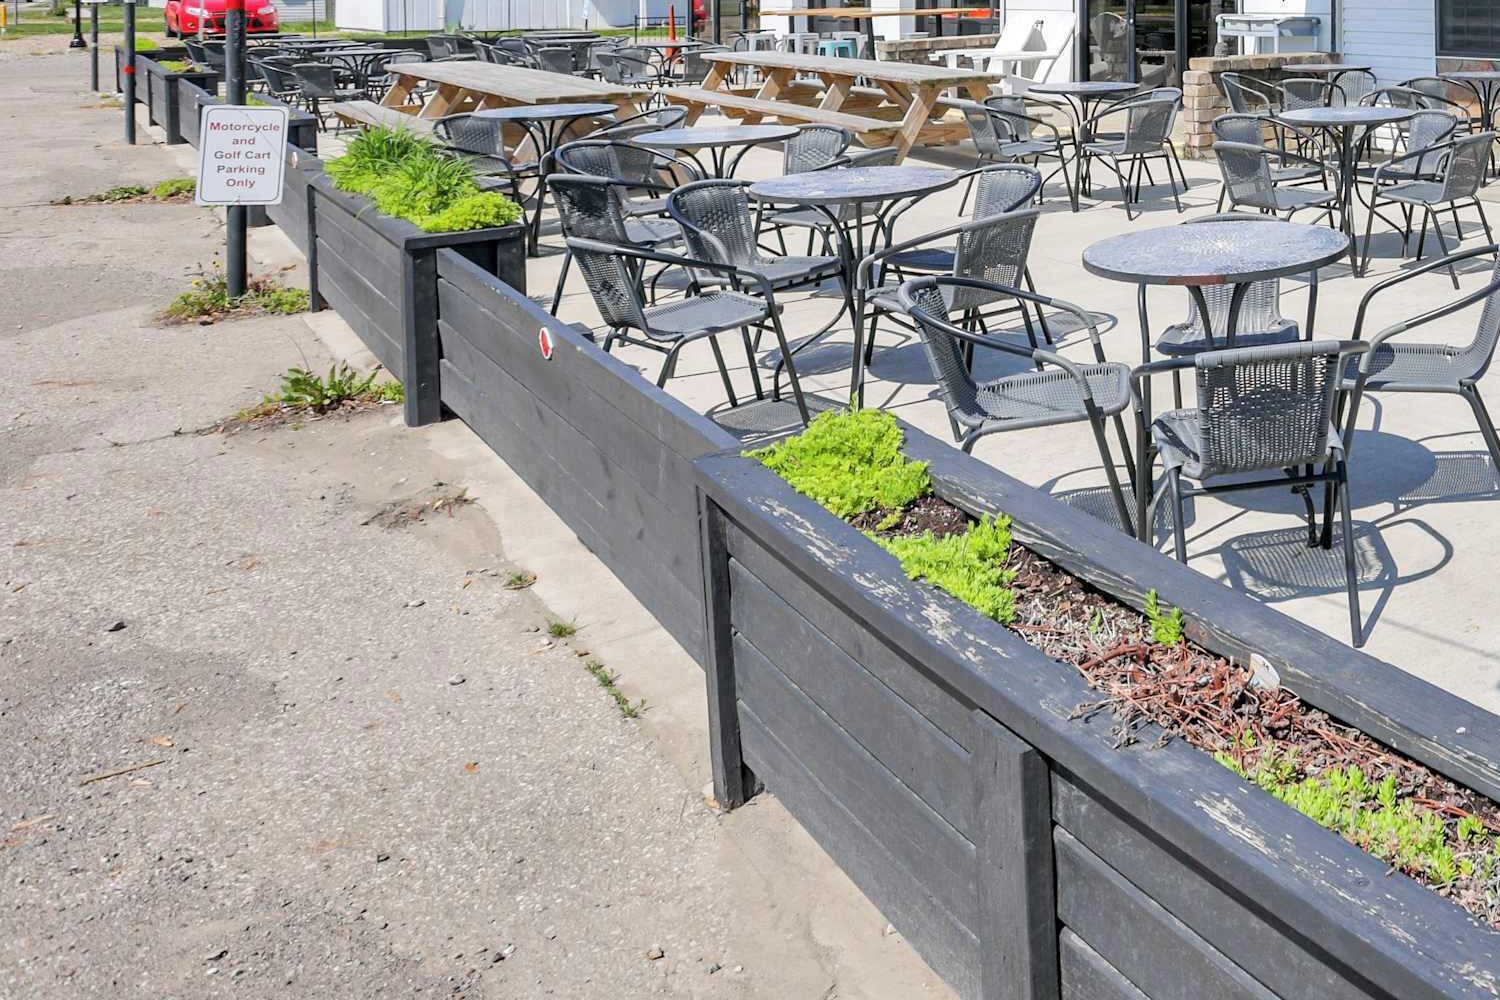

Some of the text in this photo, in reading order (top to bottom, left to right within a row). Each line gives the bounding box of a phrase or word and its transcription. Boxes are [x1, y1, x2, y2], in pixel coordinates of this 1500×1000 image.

[209, 122, 280, 133] Motorcycle
[232, 137, 255, 145] and
[214, 150, 271, 160] Golf Cart
[217, 165, 265, 175] Parking
[226, 178, 255, 189] Only
